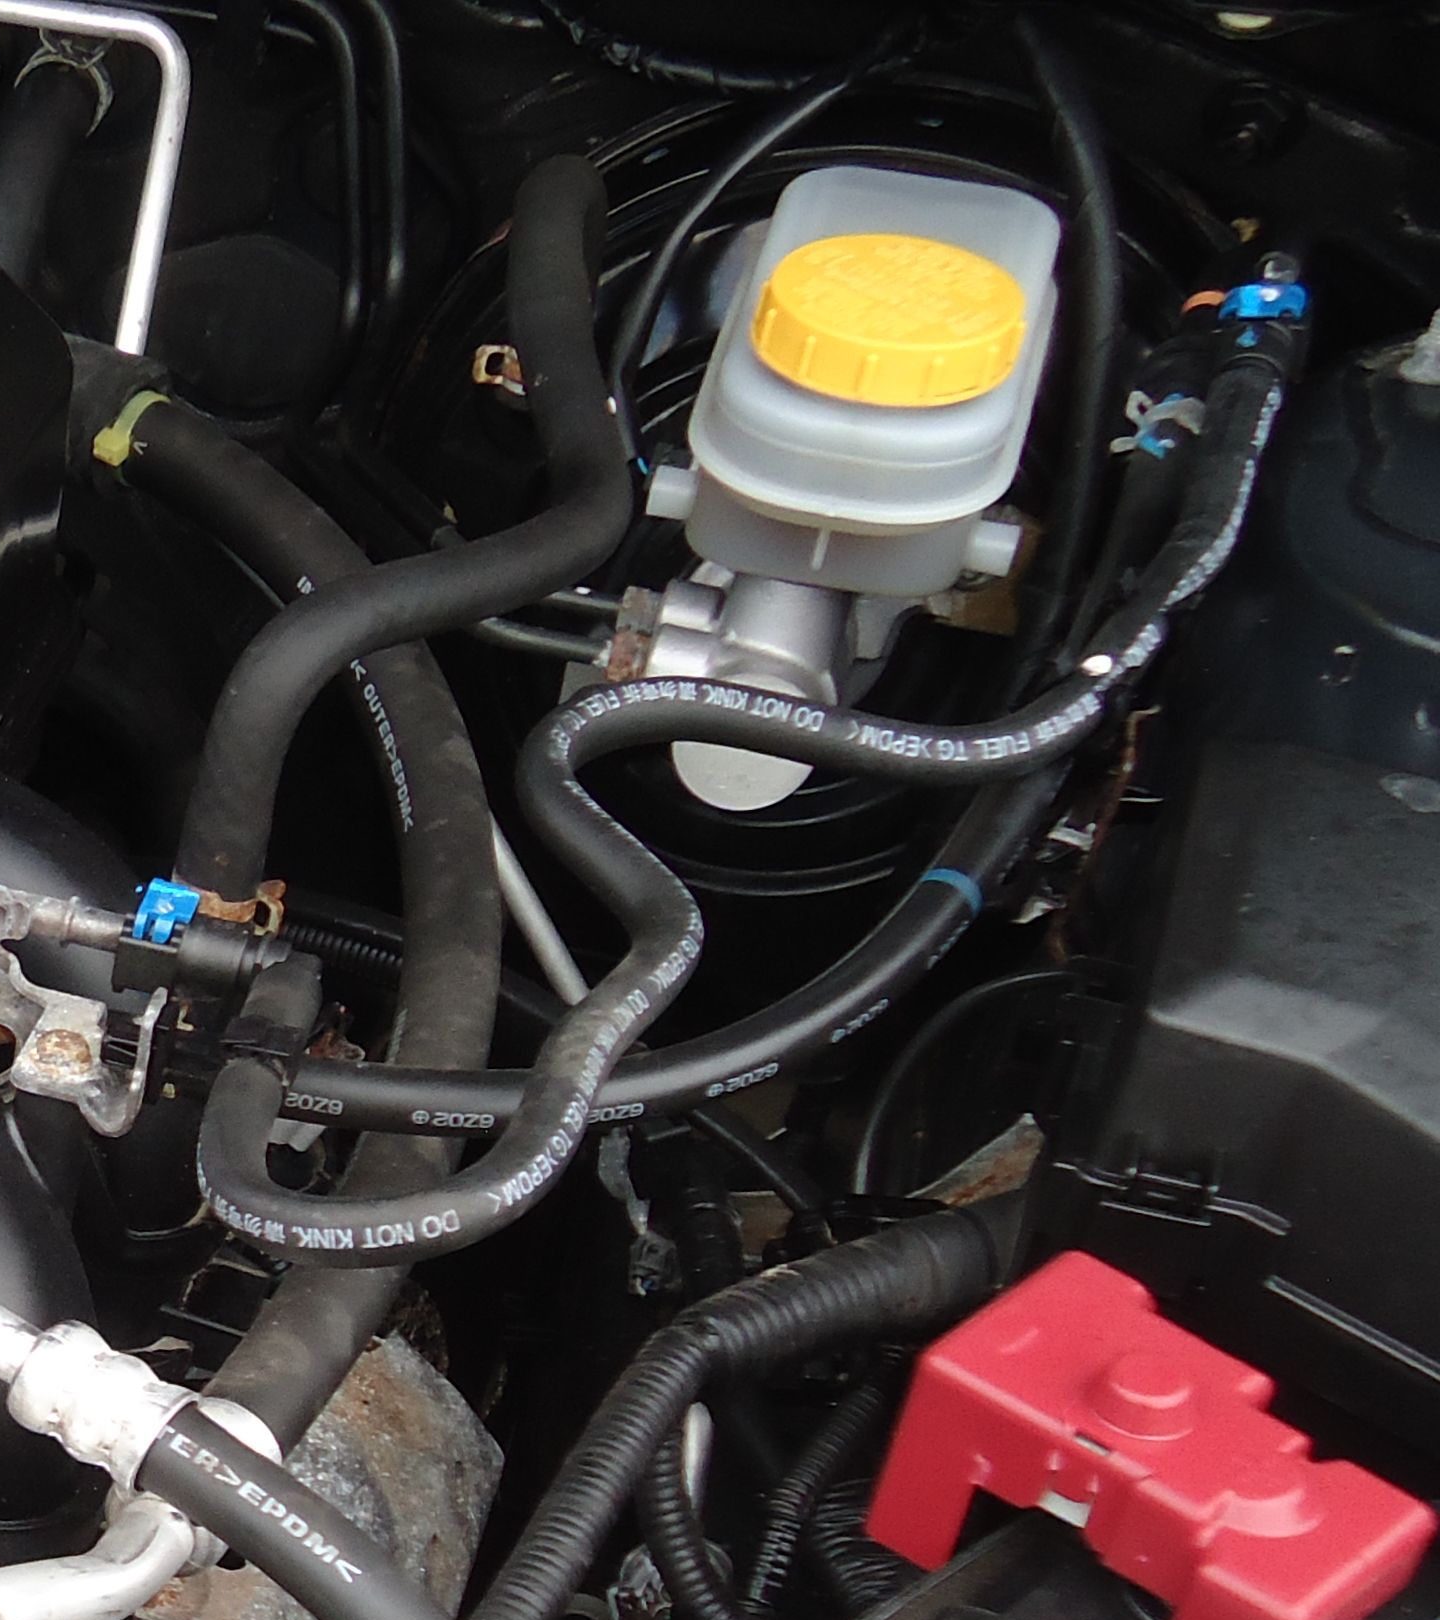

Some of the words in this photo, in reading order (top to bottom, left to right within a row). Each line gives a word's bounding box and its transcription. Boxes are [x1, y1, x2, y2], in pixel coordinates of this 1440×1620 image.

[749, 694, 793, 723] NOT
[792, 706, 825, 732] DO
[938, 745, 970, 761] TG
[972, 731, 1031, 760] FUEL
[361, 1220, 417, 1249] NOT
[422, 1208, 462, 1239] DO
